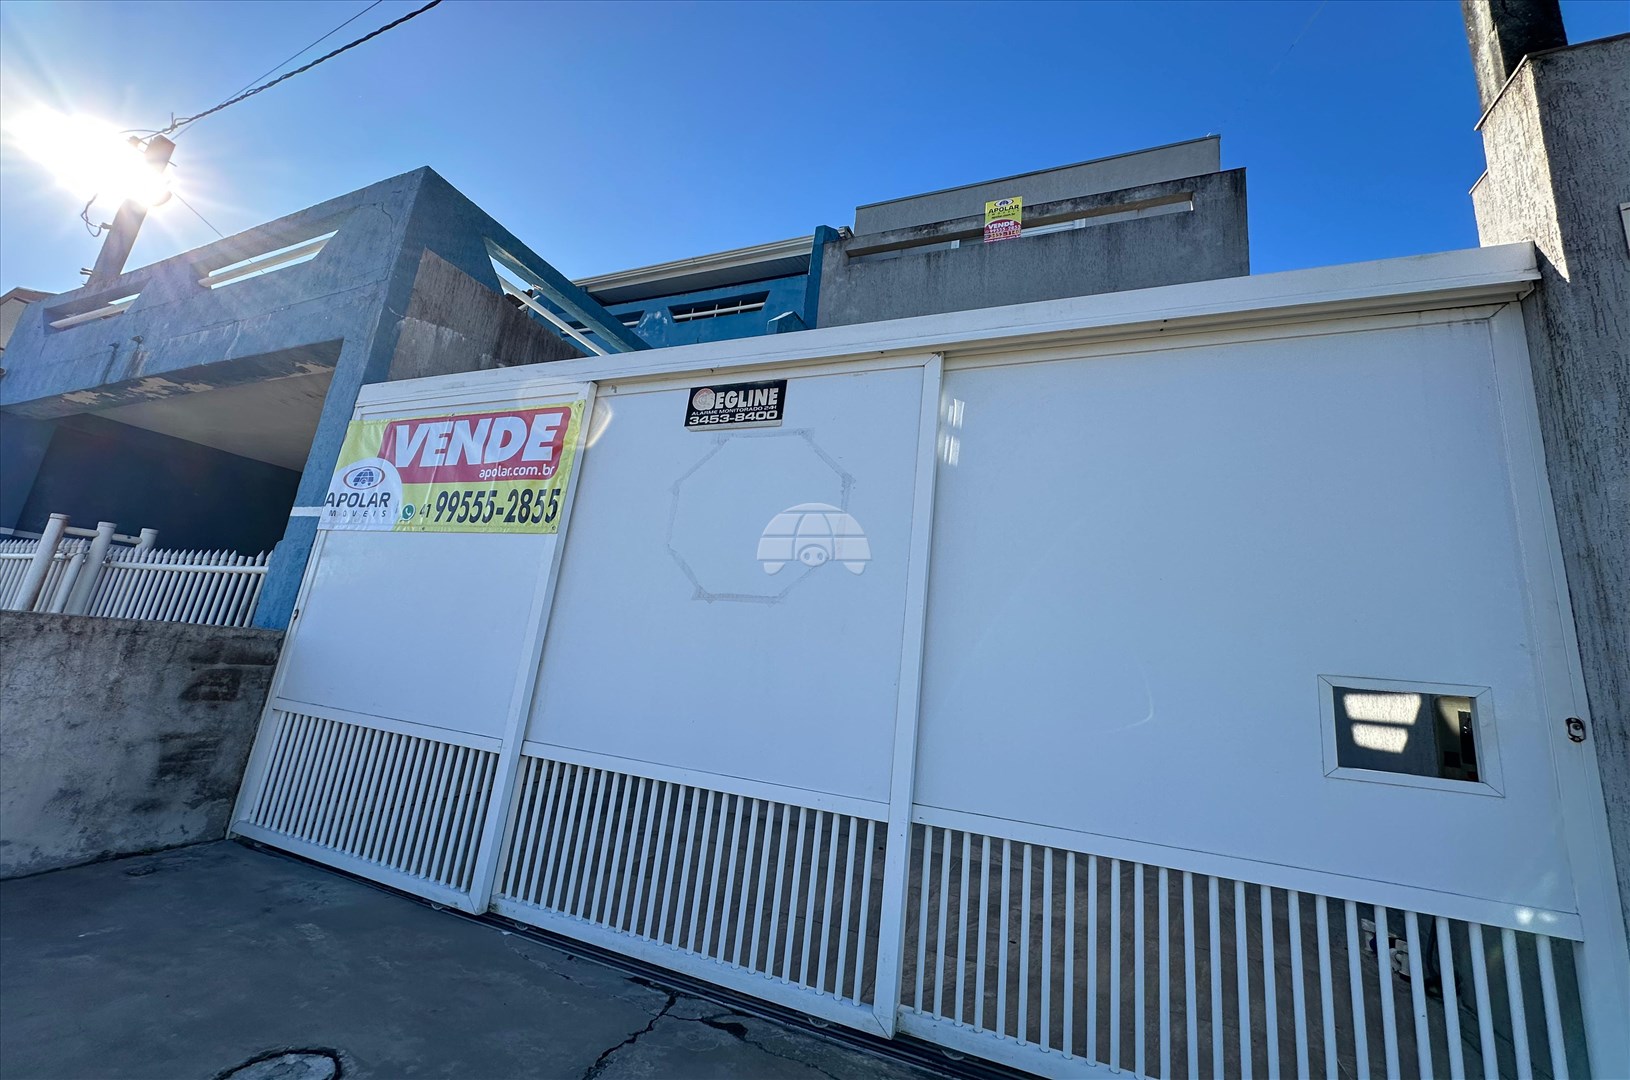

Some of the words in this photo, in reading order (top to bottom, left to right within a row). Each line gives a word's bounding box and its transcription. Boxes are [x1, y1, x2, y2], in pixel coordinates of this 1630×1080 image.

[988, 204, 1020, 214] APOLAR
[988, 221, 1015, 230] VENDE
[689, 410, 778, 425] 3453-8400
[719, 406, 763, 414] MONITORADO
[395, 412, 563, 468] VENDE
[479, 464, 555, 480] apolar.com.br
[325, 492, 391, 508] APOLAR
[419, 503, 432, 519] 41
[434, 488, 561, 524] 99555-2855
